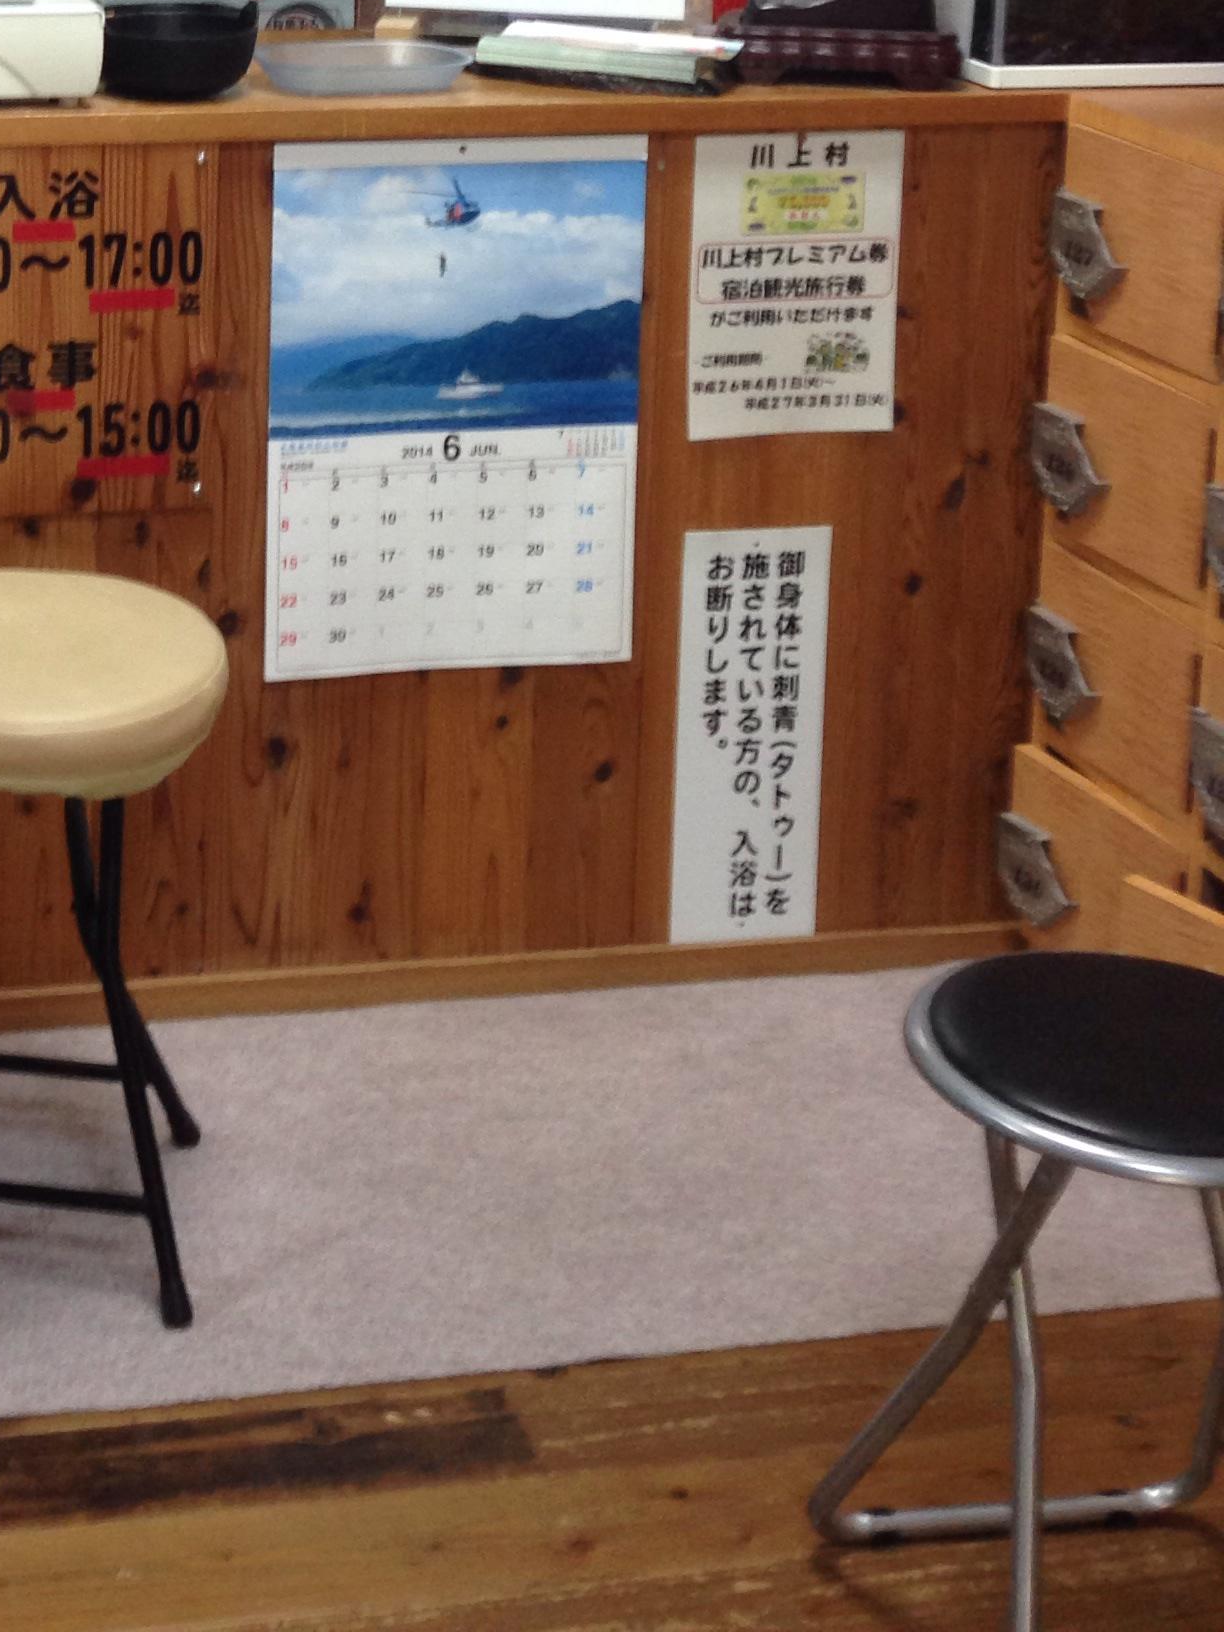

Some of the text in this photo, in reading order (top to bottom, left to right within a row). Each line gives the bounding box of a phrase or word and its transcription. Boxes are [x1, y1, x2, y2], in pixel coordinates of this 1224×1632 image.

[751, 142, 850, 169] 川上村
[401, 445, 434, 459] 2014
[442, 434, 461, 461] 6
[700, 554, 734, 751] お断りします。
[728, 829, 759, 918] 入浴は
